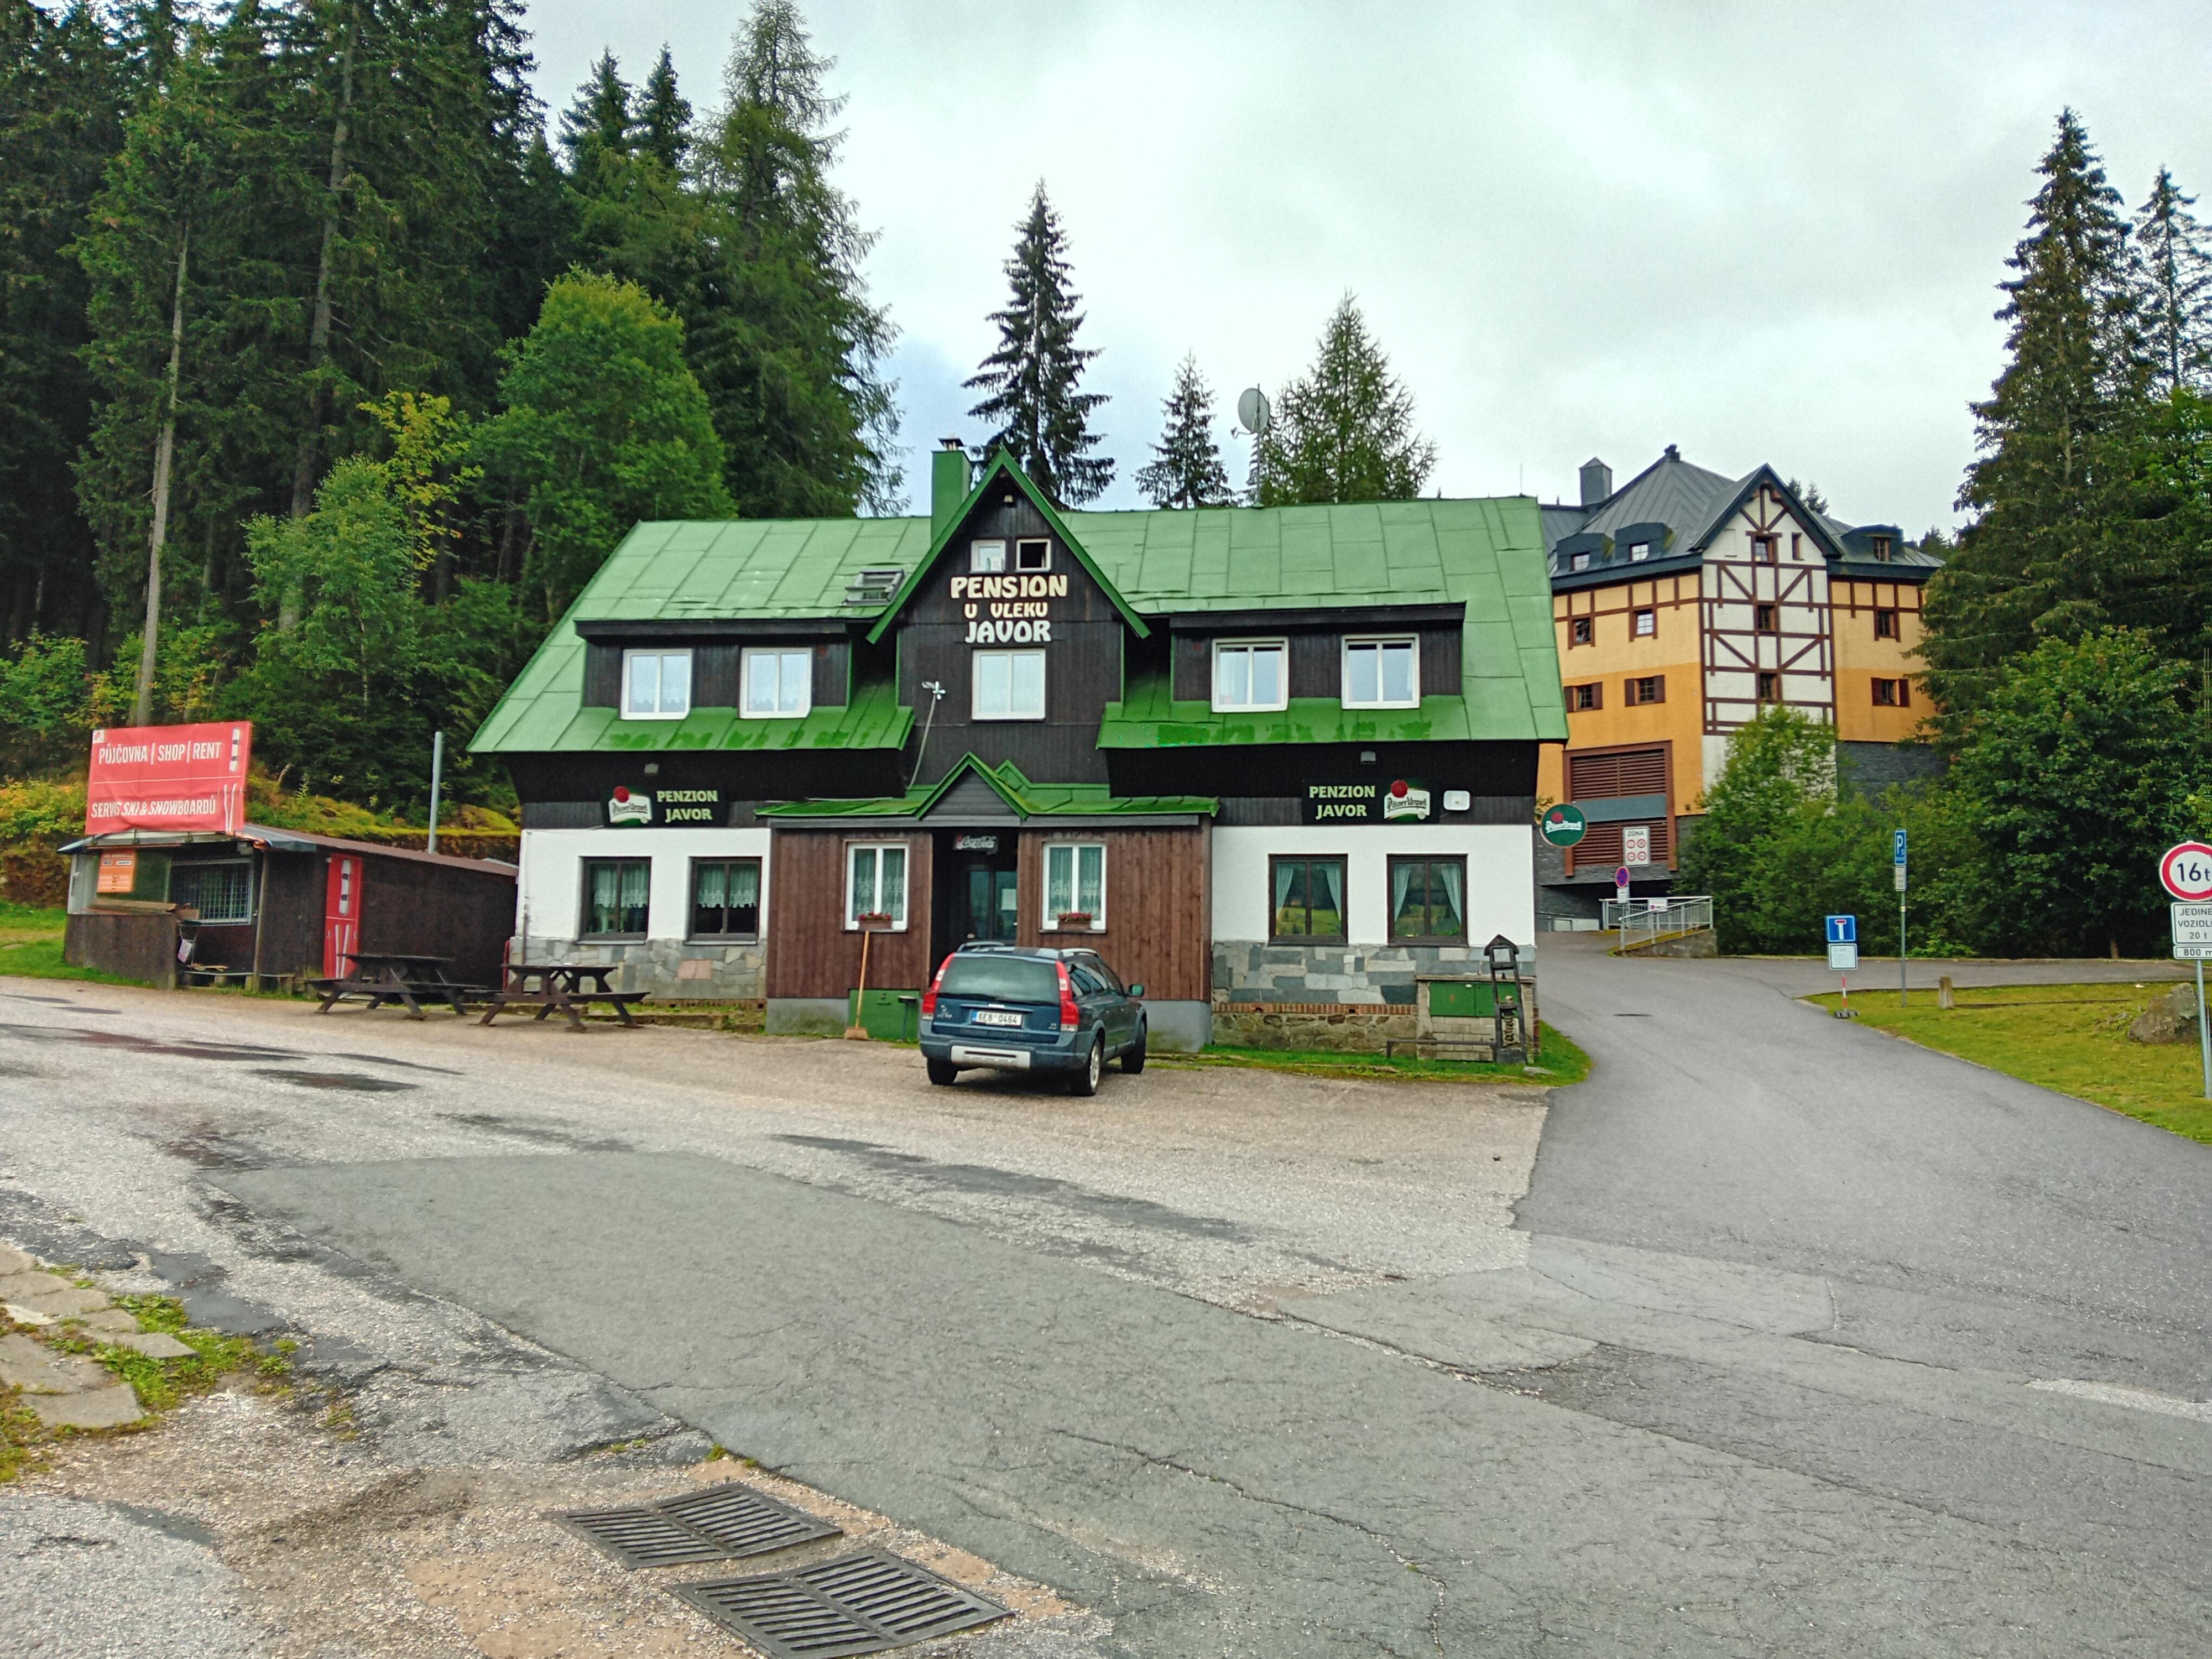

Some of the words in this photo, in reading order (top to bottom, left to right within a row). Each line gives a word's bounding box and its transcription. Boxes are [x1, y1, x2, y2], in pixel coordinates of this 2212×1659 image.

[950, 575, 1067, 598] PENSION
[964, 603, 978, 618] U
[990, 602, 1048, 618] VLEKU
[964, 620, 1052, 643] JAVOR
[98, 743, 148, 765] PŮJČOVNA
[157, 744, 185, 762] SHOP
[192, 742, 222, 759] RENT
[656, 790, 718, 802] PENZION
[1308, 785, 1376, 798] PENZION
[91, 802, 122, 818] SERVIS
[121, 801, 139, 816] SKI
[139, 801, 148, 815] &
[148, 795, 216, 816] SNOWBOARDŮ
[1315, 804, 1367, 820] JAVOR
[665, 808, 713, 823] JAVOR
